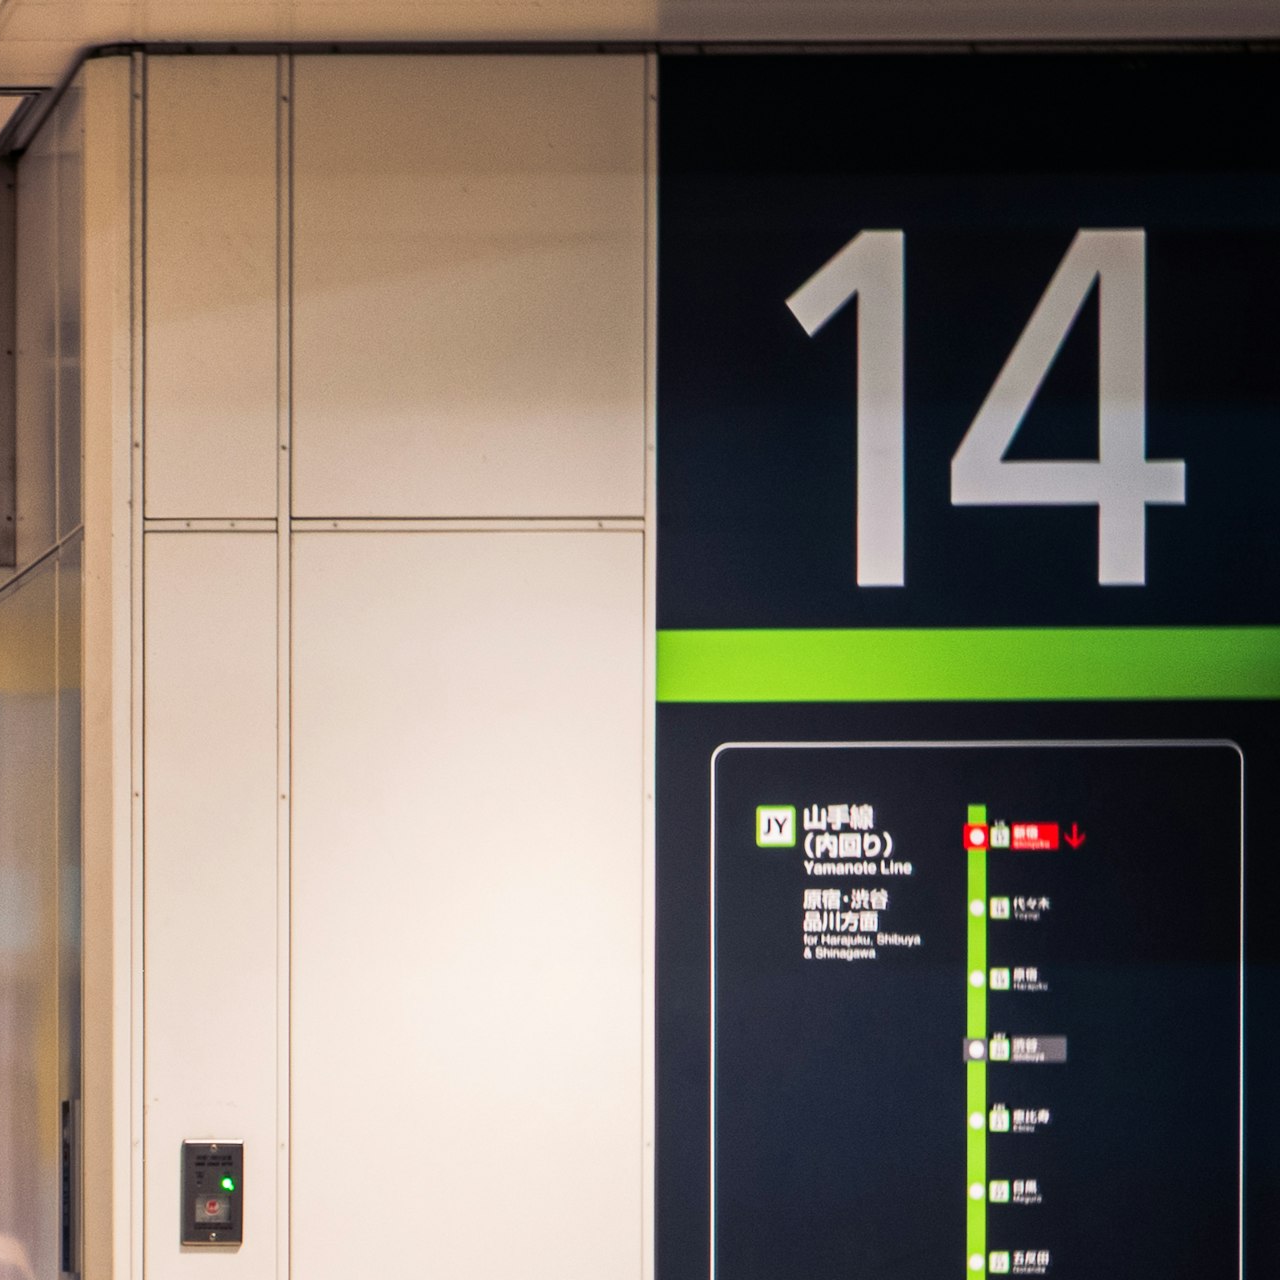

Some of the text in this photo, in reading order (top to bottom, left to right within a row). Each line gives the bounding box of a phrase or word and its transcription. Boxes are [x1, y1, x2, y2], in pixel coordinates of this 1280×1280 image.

[784, 228, 1187, 588] 14
[763, 817, 787, 835] JY
[803, 804, 874, 831] 山手線
[804, 860, 913, 876] Yamanote Line
[803, 910, 879, 933] 品川方面
[803, 933, 819, 946] for
[877, 933, 922, 948] Shibuya
[803, 946, 876, 962] & Shinagawa
